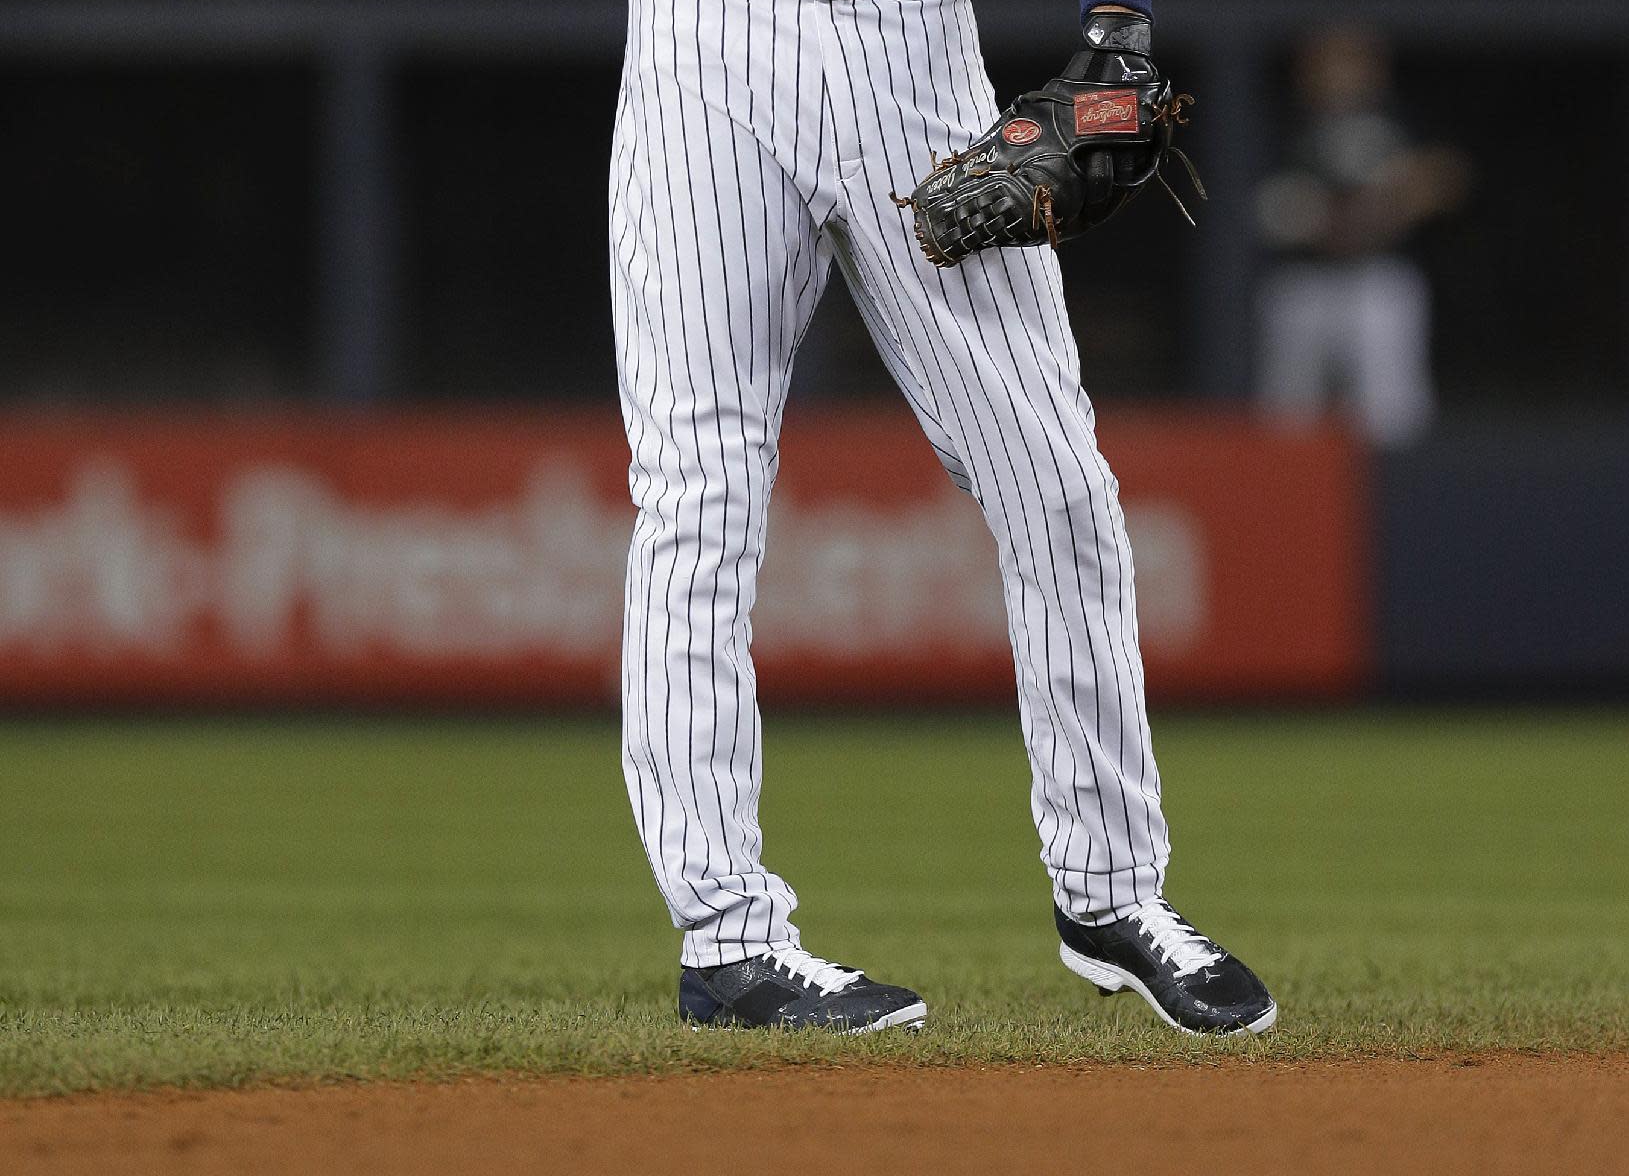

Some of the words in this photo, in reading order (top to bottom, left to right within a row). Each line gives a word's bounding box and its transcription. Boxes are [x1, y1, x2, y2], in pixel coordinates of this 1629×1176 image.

[1081, 104, 1134, 124] Rawlings
[961, 145, 999, 178] Derek
[926, 164, 957, 194] Jeter
